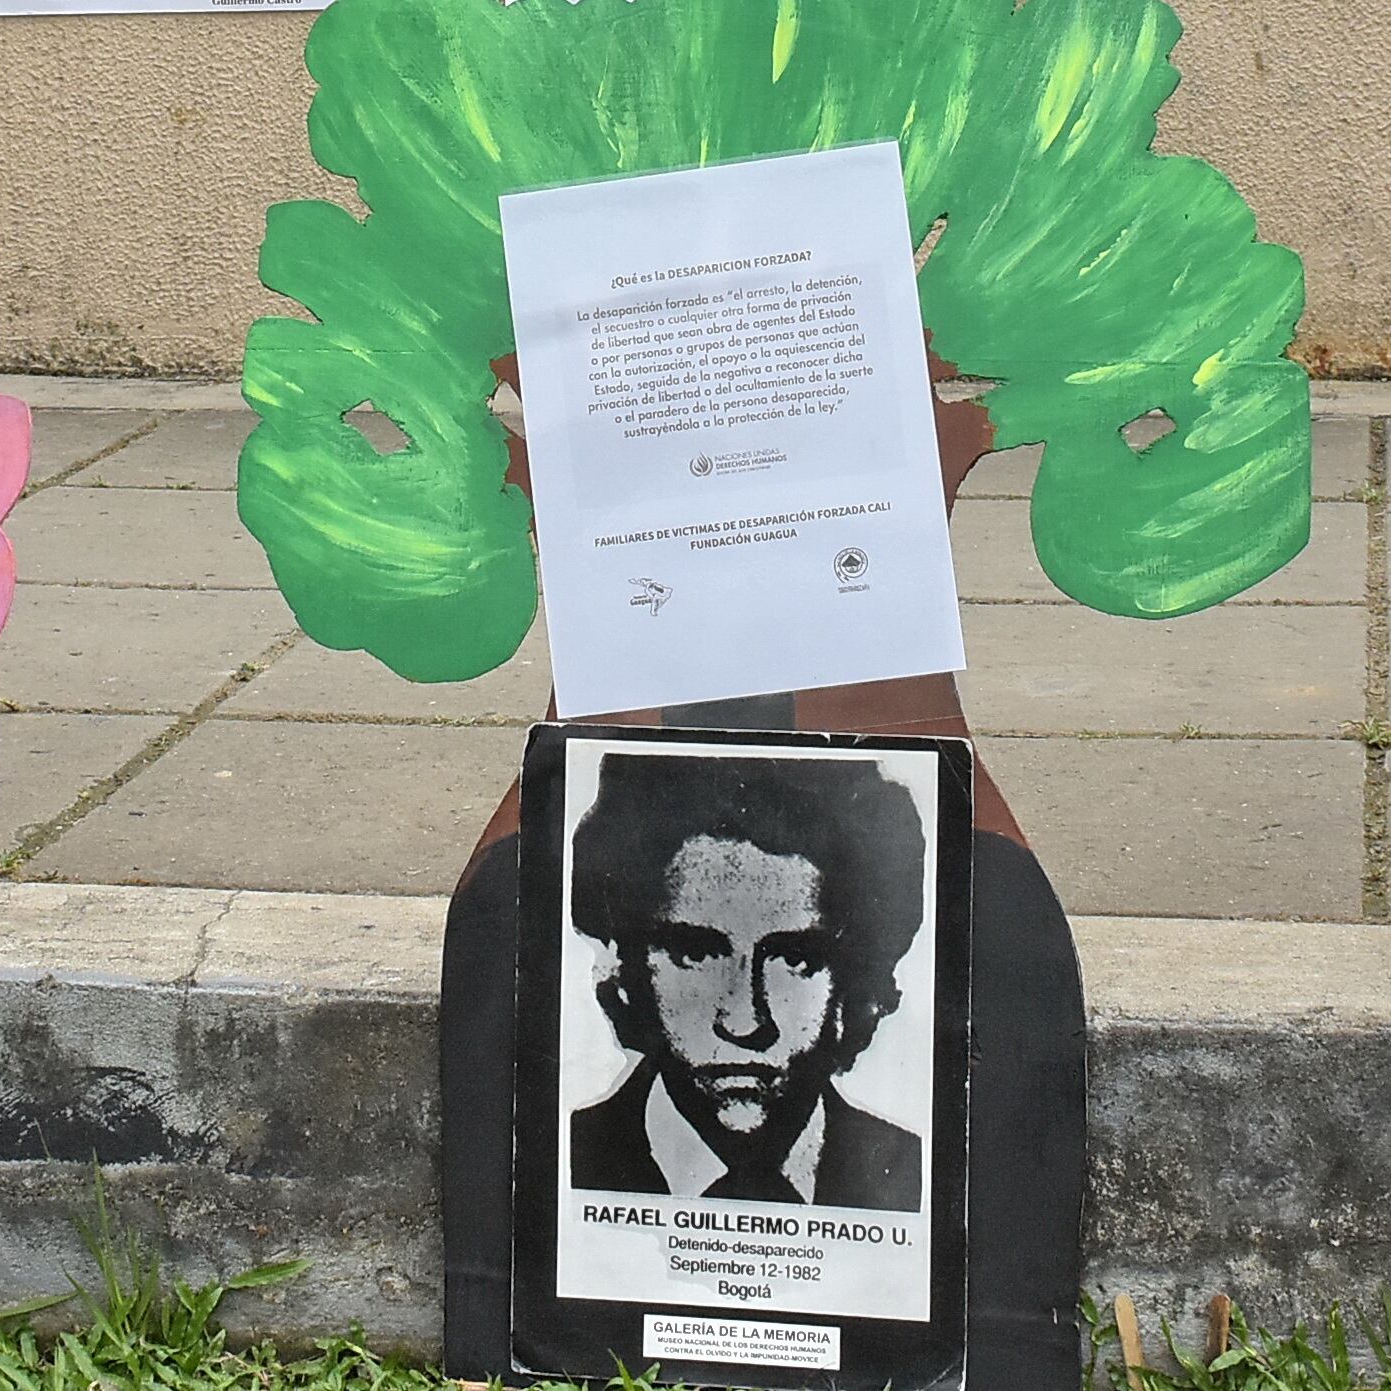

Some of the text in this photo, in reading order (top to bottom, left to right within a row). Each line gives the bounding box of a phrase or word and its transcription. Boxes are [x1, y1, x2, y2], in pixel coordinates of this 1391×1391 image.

[611, 273, 637, 288] ¿Qué
[640, 274, 653, 283] es
[654, 270, 665, 281] la
[753, 251, 811, 268] FORZADA?
[576, 311, 590, 321] La
[592, 301, 663, 319] desaparición
[665, 295, 709, 309] forzada
[712, 294, 724, 303] es
[746, 286, 789, 299] arresto,
[791, 284, 802, 292] la
[805, 276, 862, 295] detención,
[591, 292, 851, 334] el secuestro o cualquier otra forma de privación
[624, 419, 700, 438] sustrayéndola
[713, 416, 724, 426] la
[727, 408, 784, 427] protección
[787, 406, 801, 416] de
[804, 404, 815, 414] la
[594, 501, 890, 547] FAMILIARES DE VICTIMAS DE DESAPARICIÓN FORZADA CALI
[690, 528, 797, 550] FUNDACIÓN GUAGUA
[583, 1206, 912, 1246] RAFAEL GUILLERMO PRADO U.
[668, 1236, 823, 1260] Detenido-desaparecido
[670, 1257, 821, 1281] Septiembre 12-1982
[718, 1281, 771, 1299] Bogotá
[653, 1321, 830, 1344] GALERÍA DE LA MEMORIA
